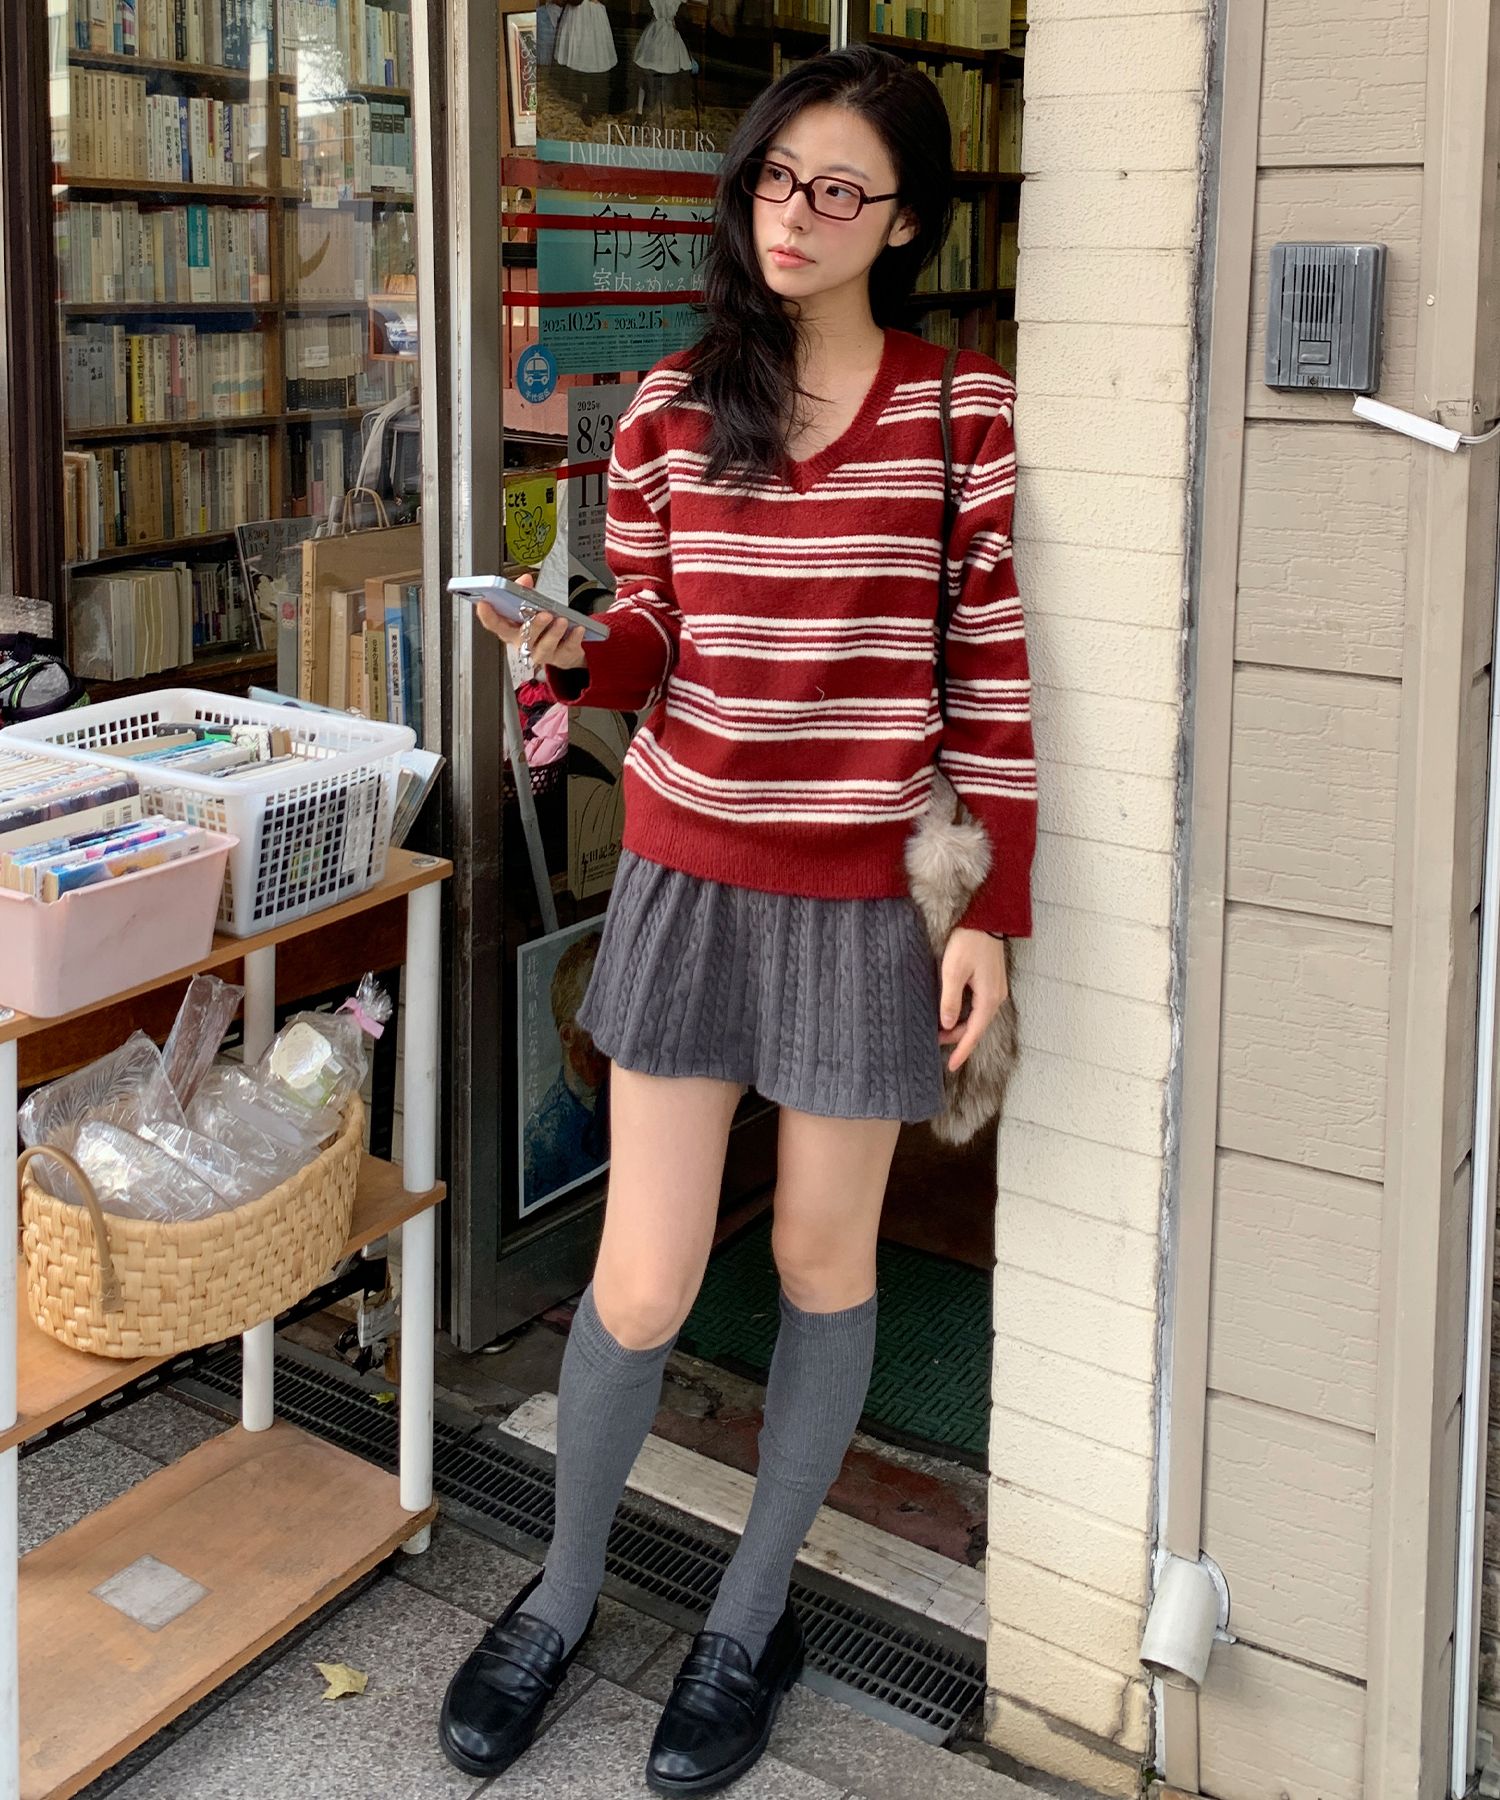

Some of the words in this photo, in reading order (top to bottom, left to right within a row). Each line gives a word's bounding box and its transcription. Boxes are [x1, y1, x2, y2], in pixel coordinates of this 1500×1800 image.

[607, 121, 716, 153] INTÉRIEURS
[569, 141, 724, 172] IMPRESSIONNIS
[614, 310, 663, 331] 2026.2.15
[577, 413, 624, 454] 8/3
[508, 491, 527, 507] こども
